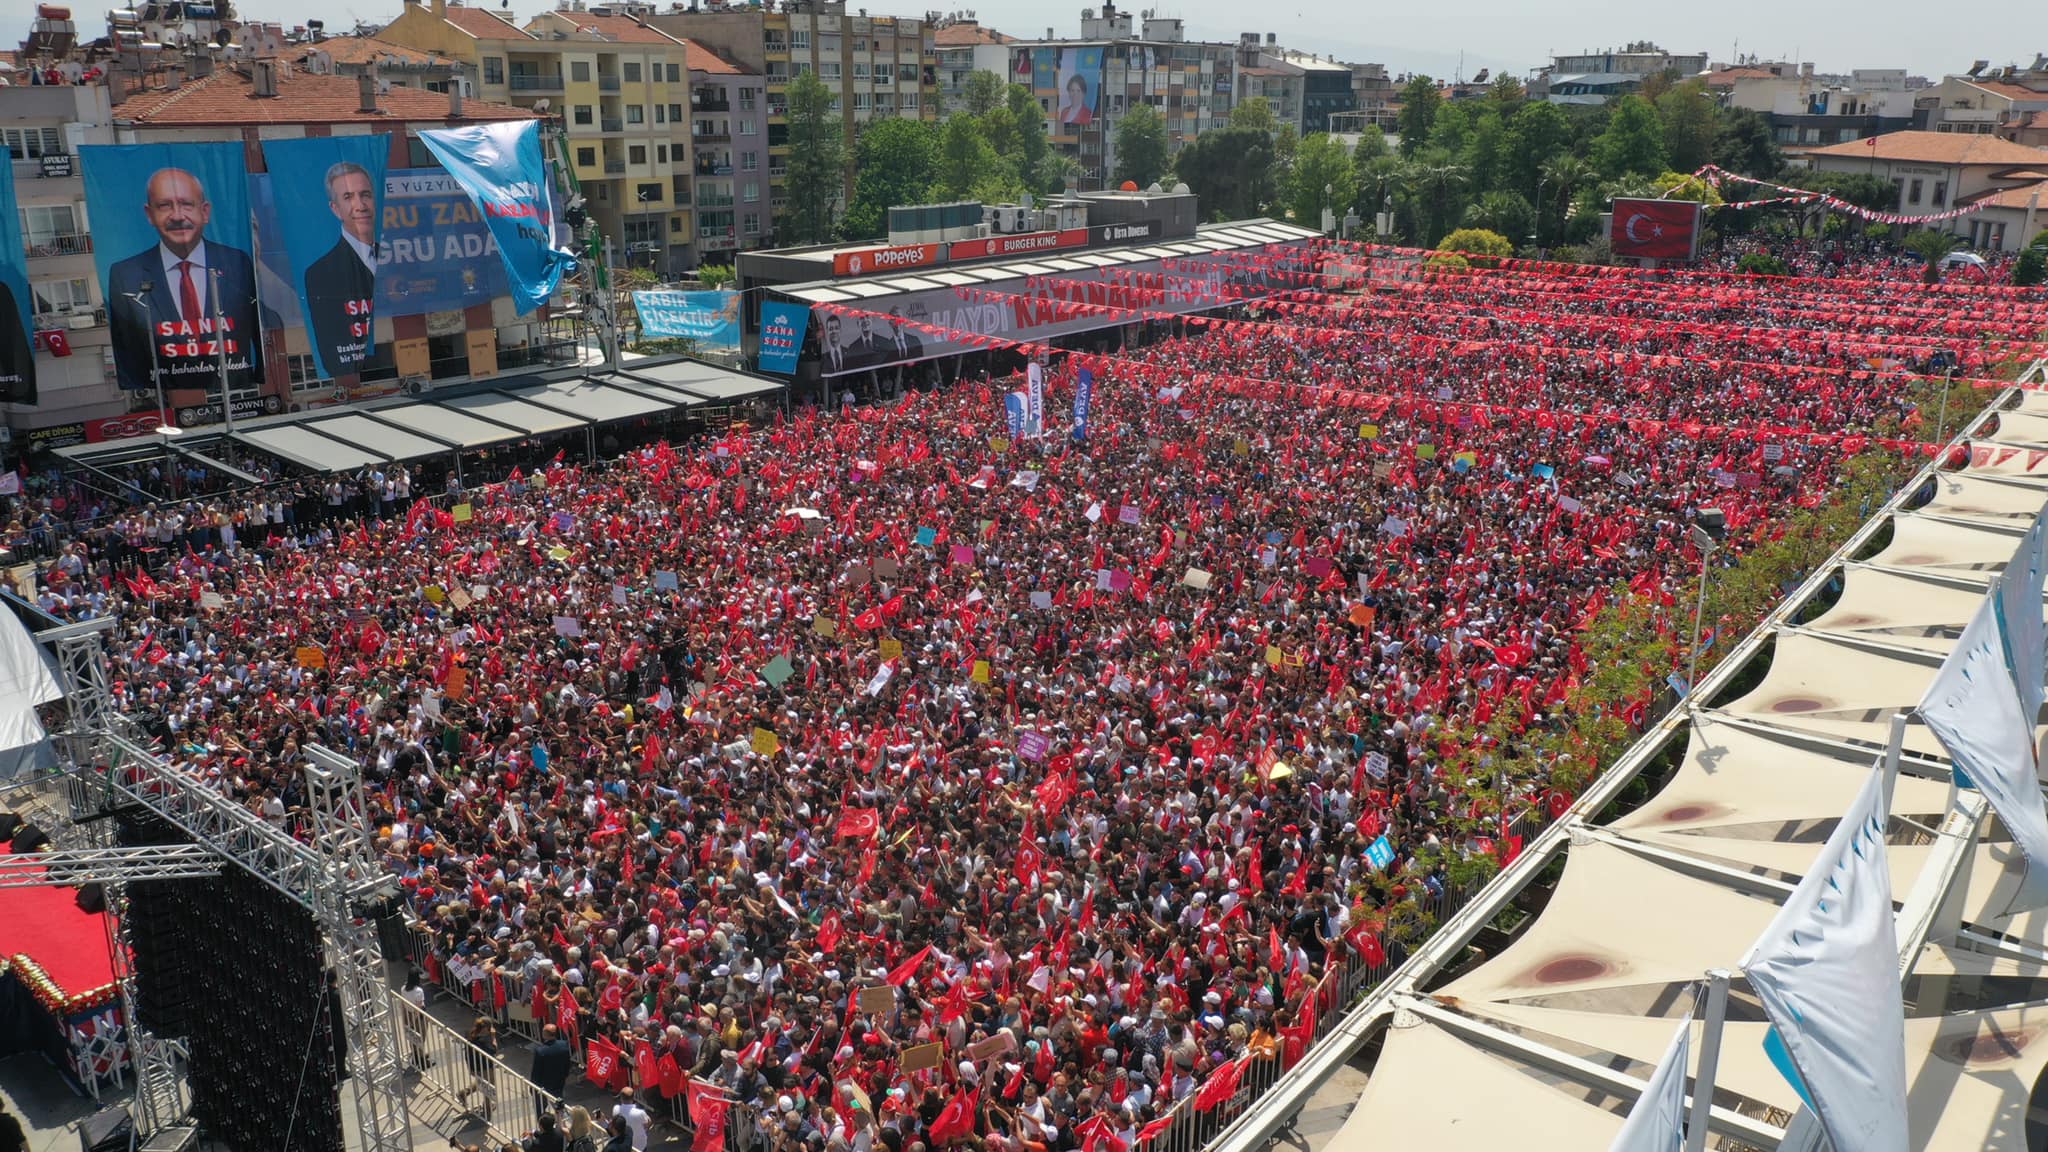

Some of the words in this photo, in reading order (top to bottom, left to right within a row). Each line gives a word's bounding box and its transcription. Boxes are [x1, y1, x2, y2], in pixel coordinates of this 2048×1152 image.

[383, 204, 418, 229] RU
[1004, 238, 1036, 251] BURGER
[1037, 235, 1057, 248] KING
[161, 317, 231, 336] SANA
[766, 326, 794, 337] SANA
[164, 338, 234, 358] SÖZ!
[1031, 380, 1040, 414] DEVA
[1078, 382, 1088, 415] DEVA
[196, 406, 222, 417] CAE
[230, 400, 264, 412] ROWNI
[598, 1056, 612, 1076] CHP
